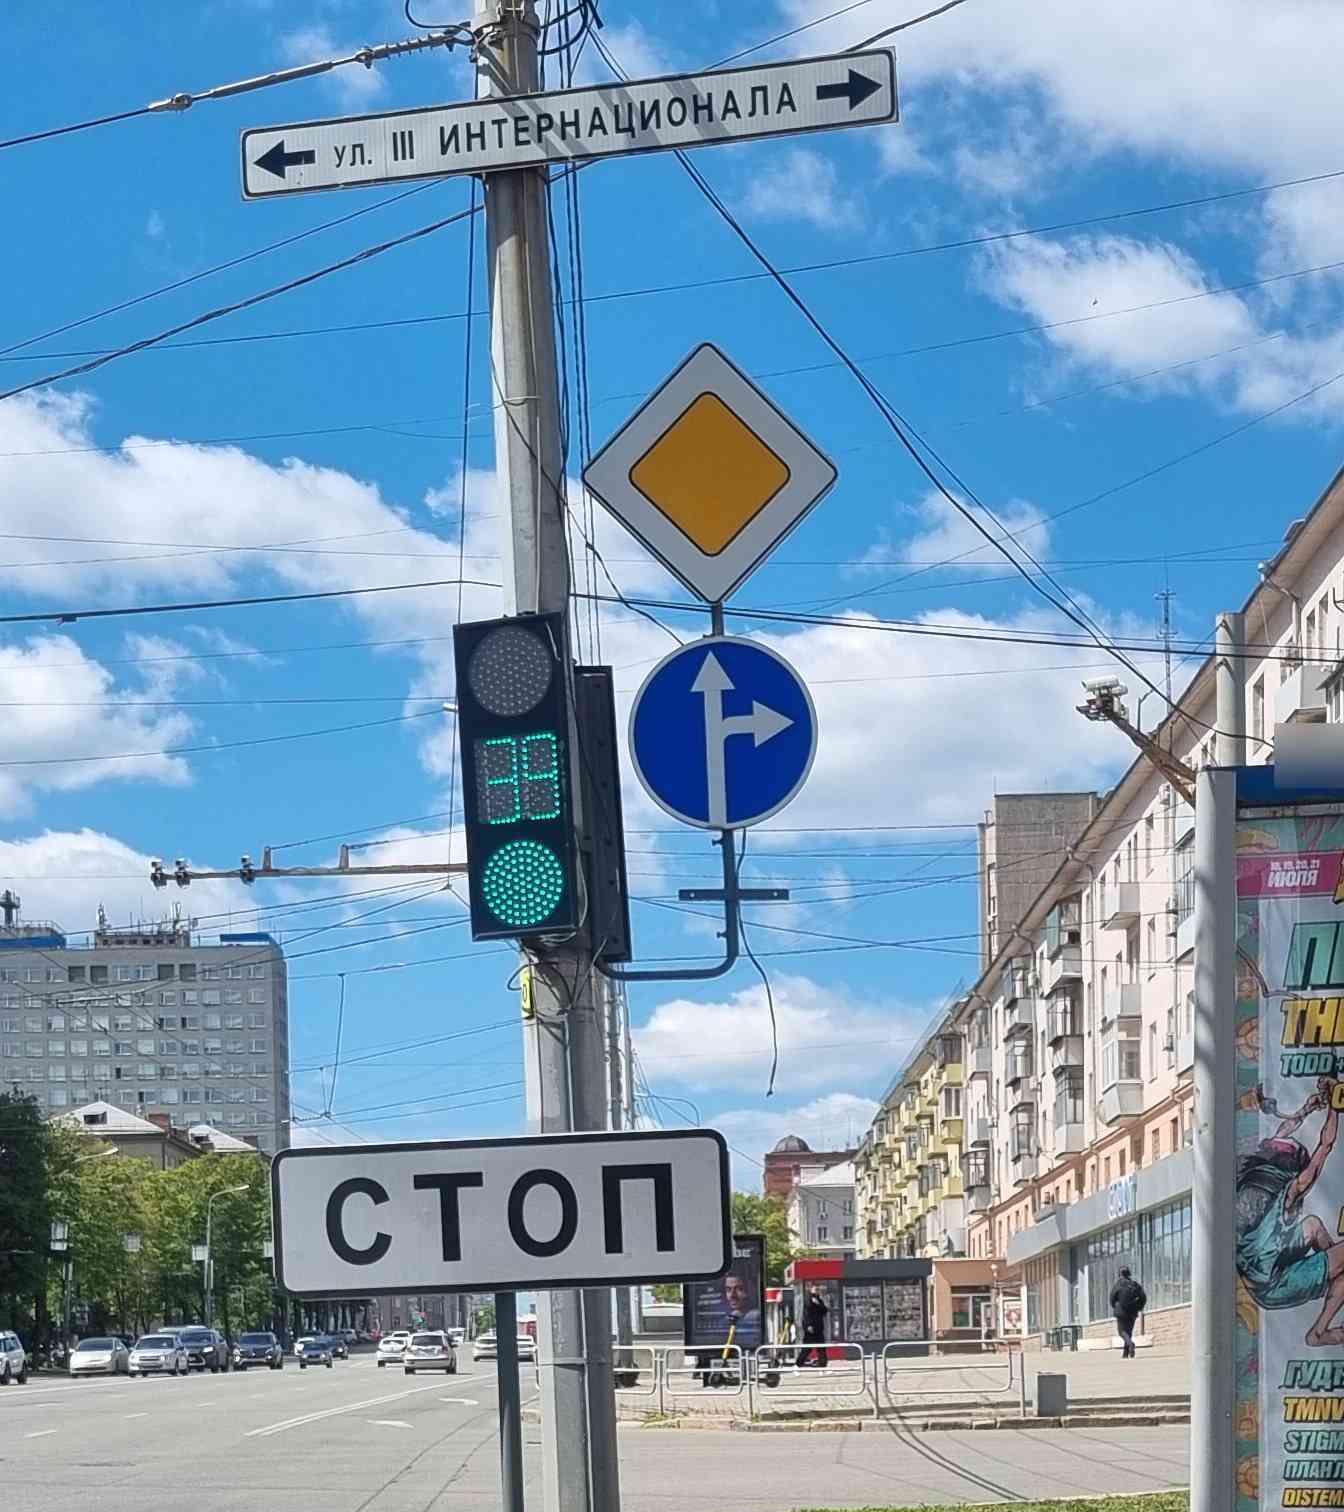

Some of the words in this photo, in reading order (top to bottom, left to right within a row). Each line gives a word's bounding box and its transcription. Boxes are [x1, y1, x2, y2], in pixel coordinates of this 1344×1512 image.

[392, 127, 415, 162] III
[440, 80, 798, 158] ИНТЕРНАЦИОНАЛА
[1267, 870, 1318, 887] ИЮЛЯ
[1280, 1053, 1336, 1077] TODD
[325, 1162, 676, 1266] СТОП
[1283, 1459, 1335, 1481] ПЛАН
